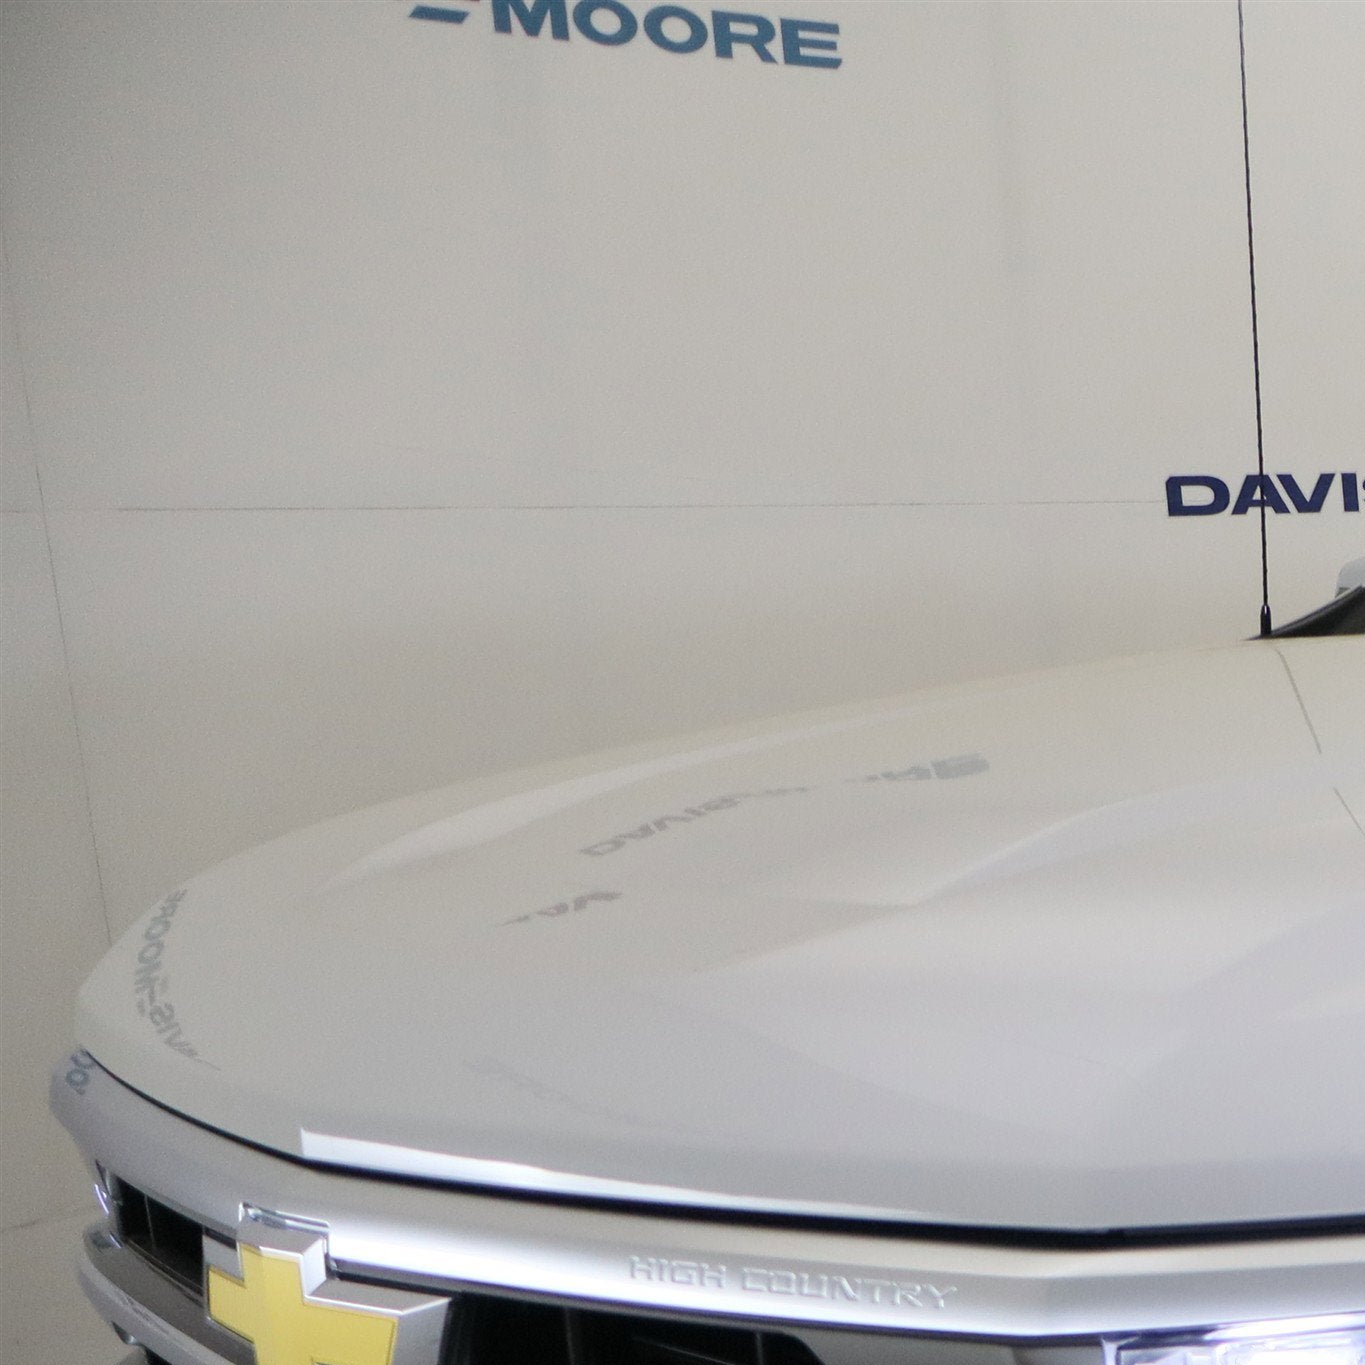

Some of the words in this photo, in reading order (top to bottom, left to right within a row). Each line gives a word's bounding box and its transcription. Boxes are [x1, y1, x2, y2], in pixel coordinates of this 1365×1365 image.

[491, 0, 843, 70] MOORE
[628, 1255, 727, 1289] HIGH
[742, 1266, 958, 1310] COUNTRY
